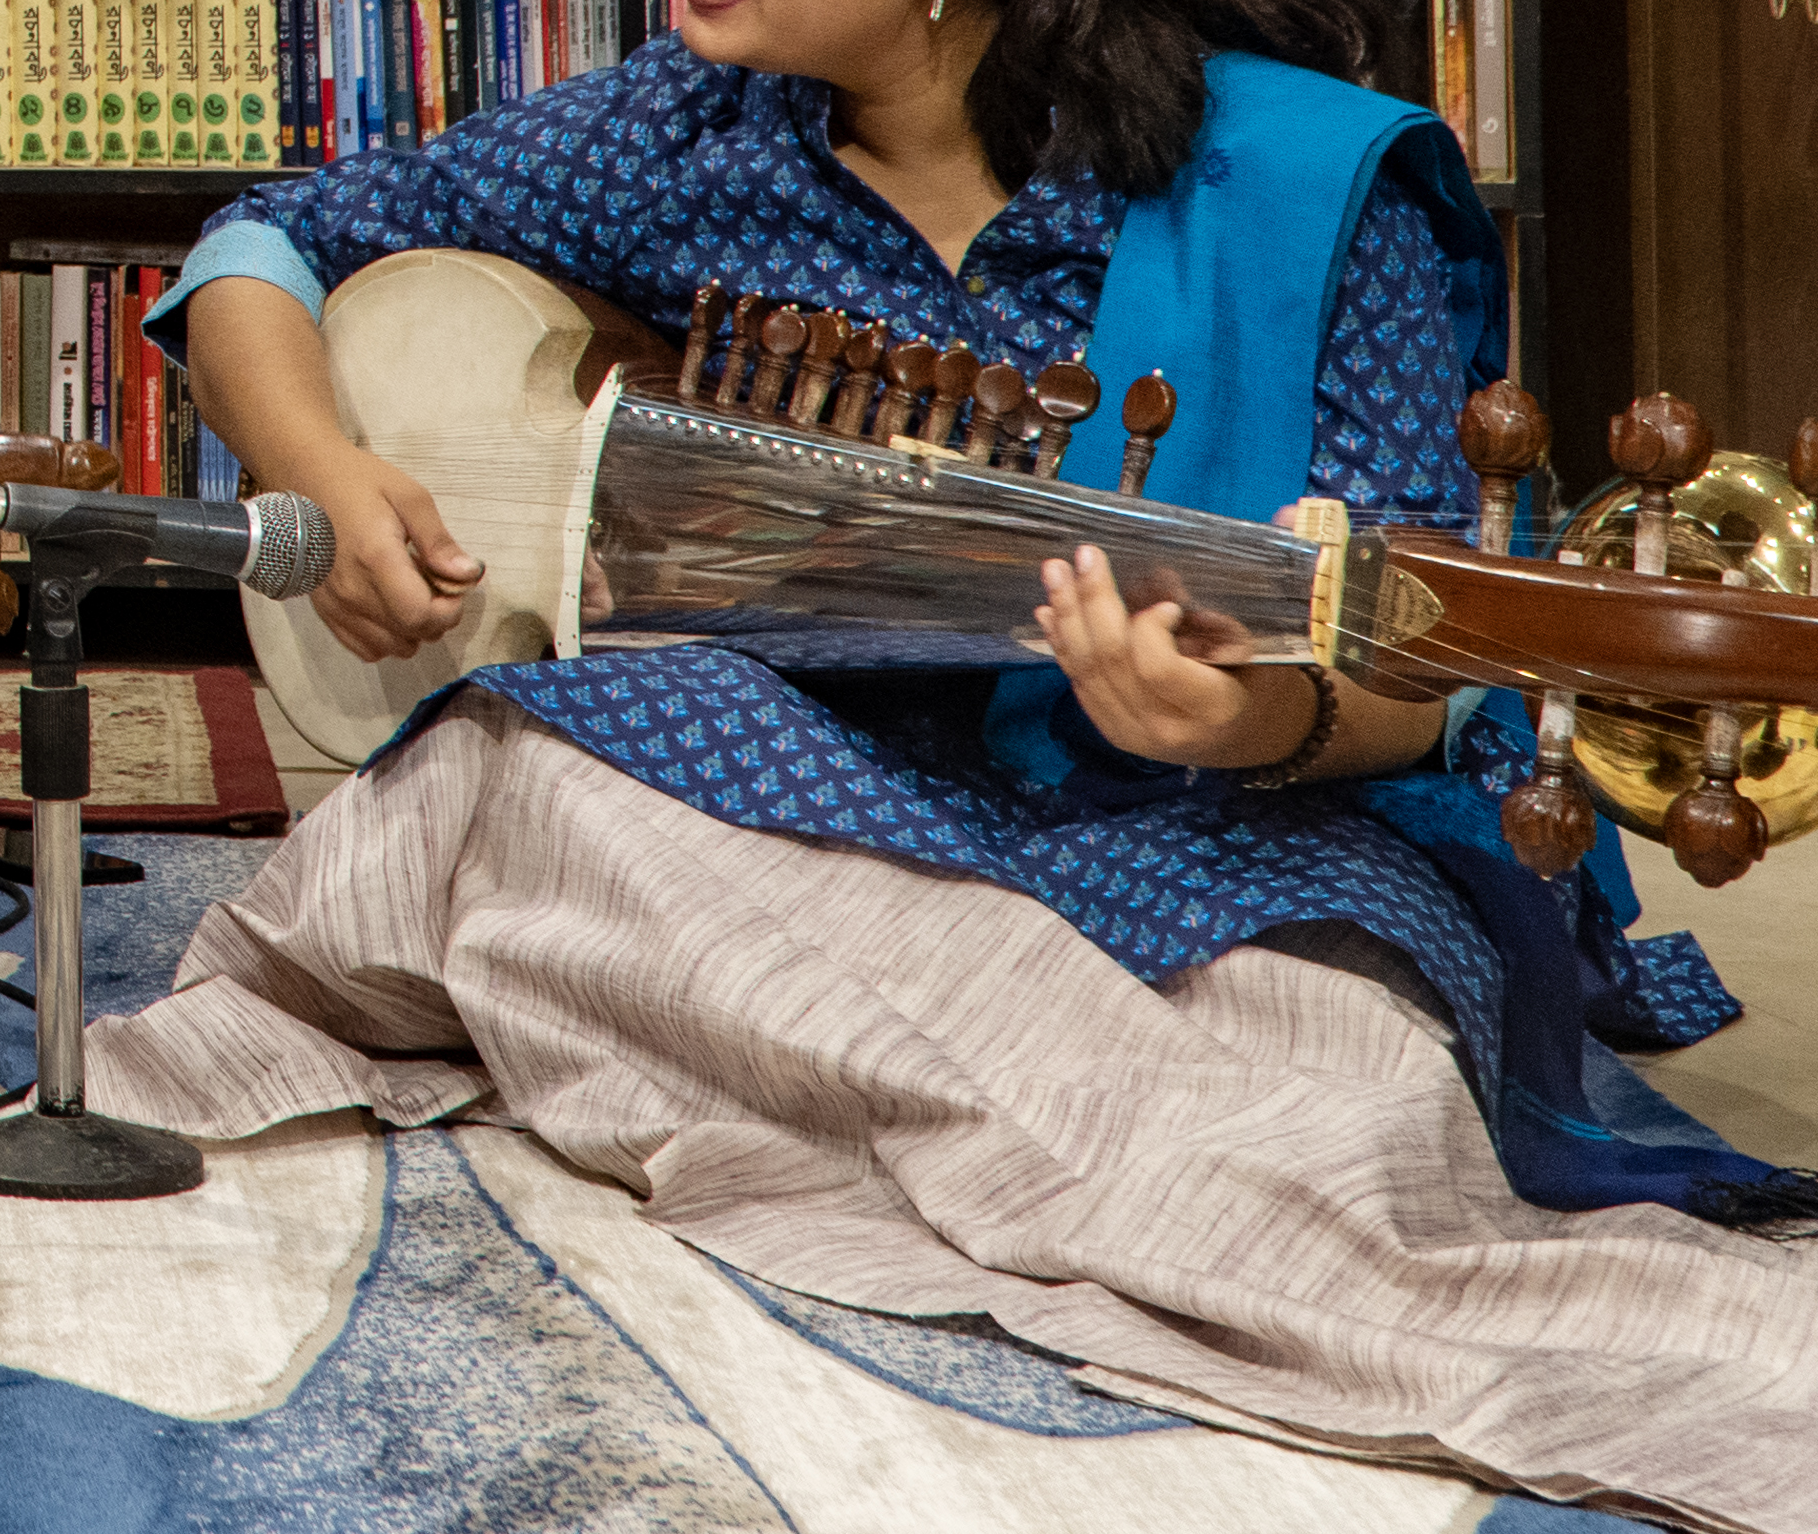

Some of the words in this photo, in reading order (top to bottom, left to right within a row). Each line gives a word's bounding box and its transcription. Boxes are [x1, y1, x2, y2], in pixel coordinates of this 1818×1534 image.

[23, 6, 48, 84] রচনাবলী
[67, 5, 93, 82] রচনাবলী
[104, 4, 130, 83] রচনাবলী
[140, 3, 165, 82] রচনাবলী
[177, 4, 199, 82] রচনাবলী
[208, 4, 233, 83] রচনাবলী
[243, 4, 270, 83] রচনাবলী
[65, 98, 83, 115] ৪
[138, 100, 159, 114] ৮
